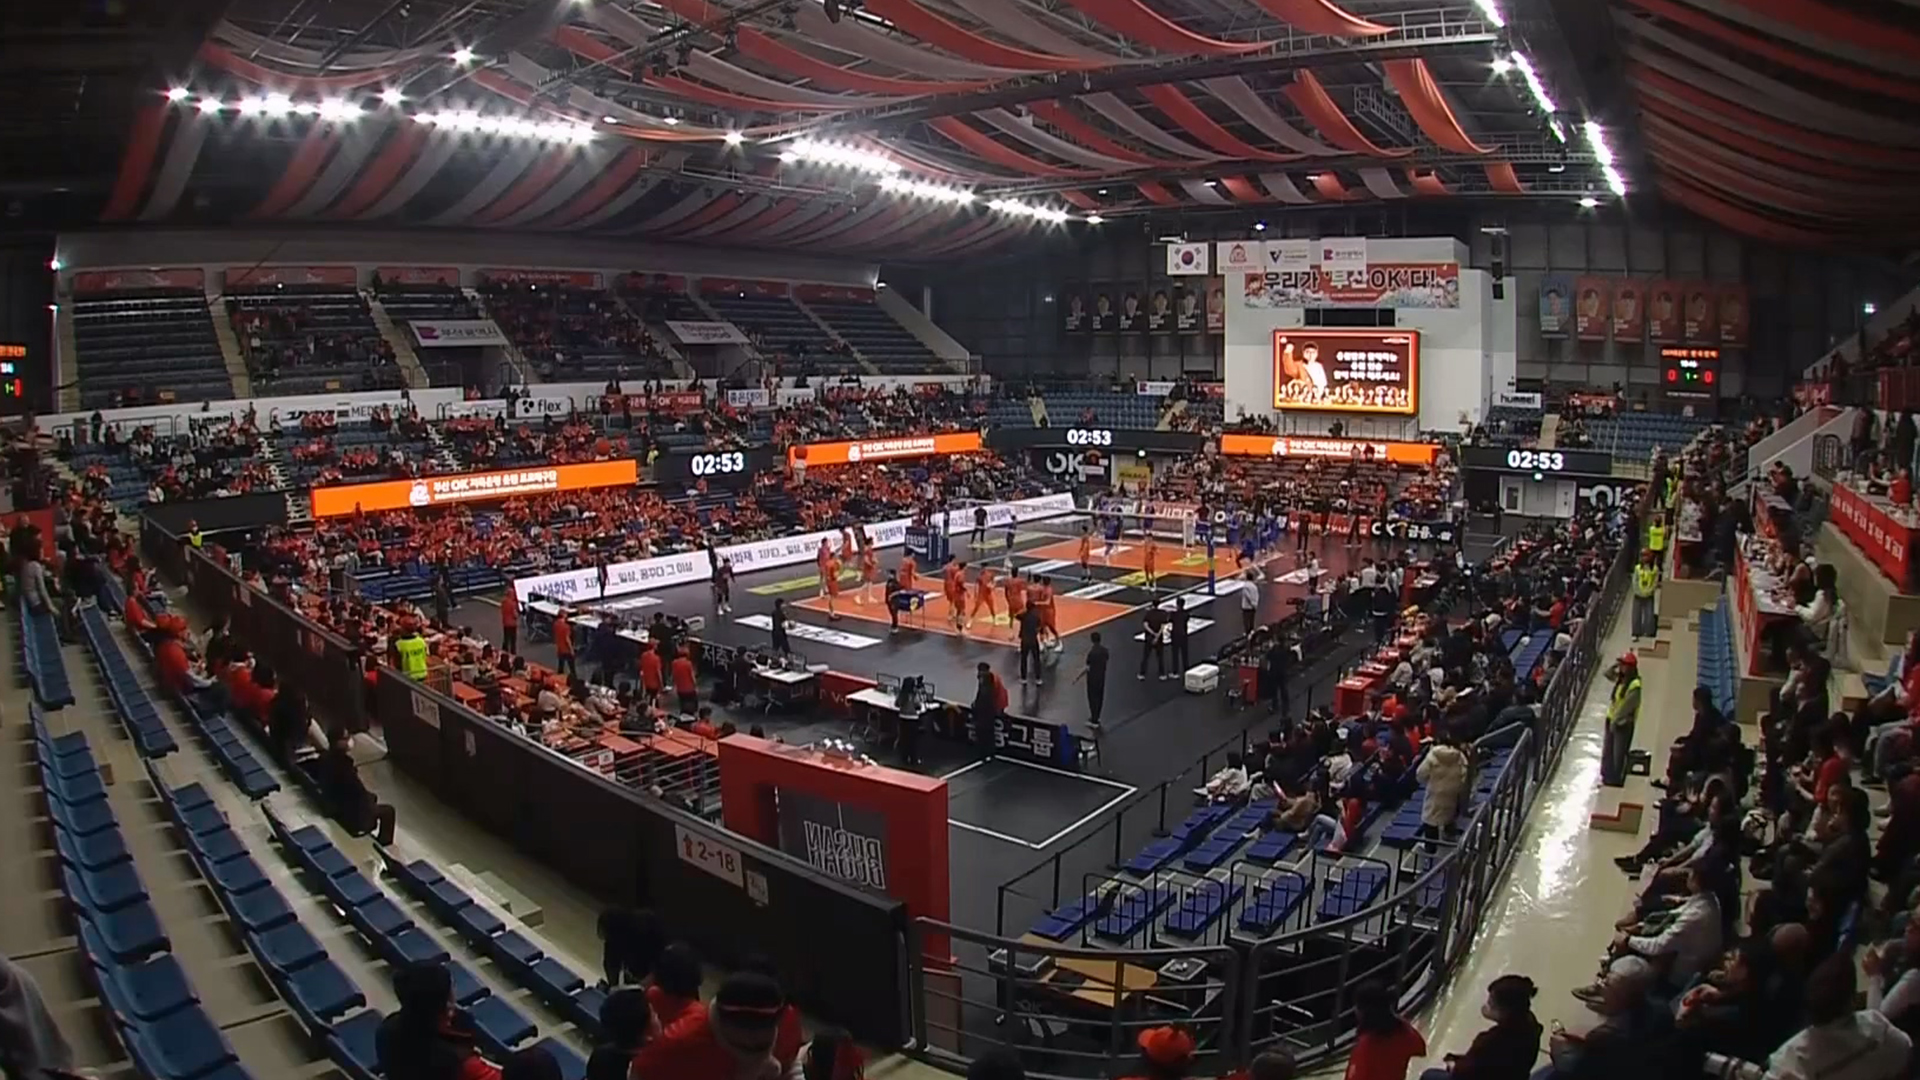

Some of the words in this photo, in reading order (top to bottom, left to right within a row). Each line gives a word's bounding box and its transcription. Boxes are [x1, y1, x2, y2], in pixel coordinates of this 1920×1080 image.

[1263, 271, 1319, 289] 우리가
[537, 400, 562, 412] flex
[729, 391, 763, 405] 좋은데이
[1501, 394, 1535, 404] hummel
[1067, 429, 1112, 446] 02:53
[691, 452, 744, 476] 02:53
[1508, 451, 1564, 470] 02:53
[451, 479, 469, 490] OK
[875, 525, 904, 542] 삼성화재
[666, 564, 676, 576] 그
[677, 561, 693, 574] 이상
[697, 841, 736, 873] 2-18
